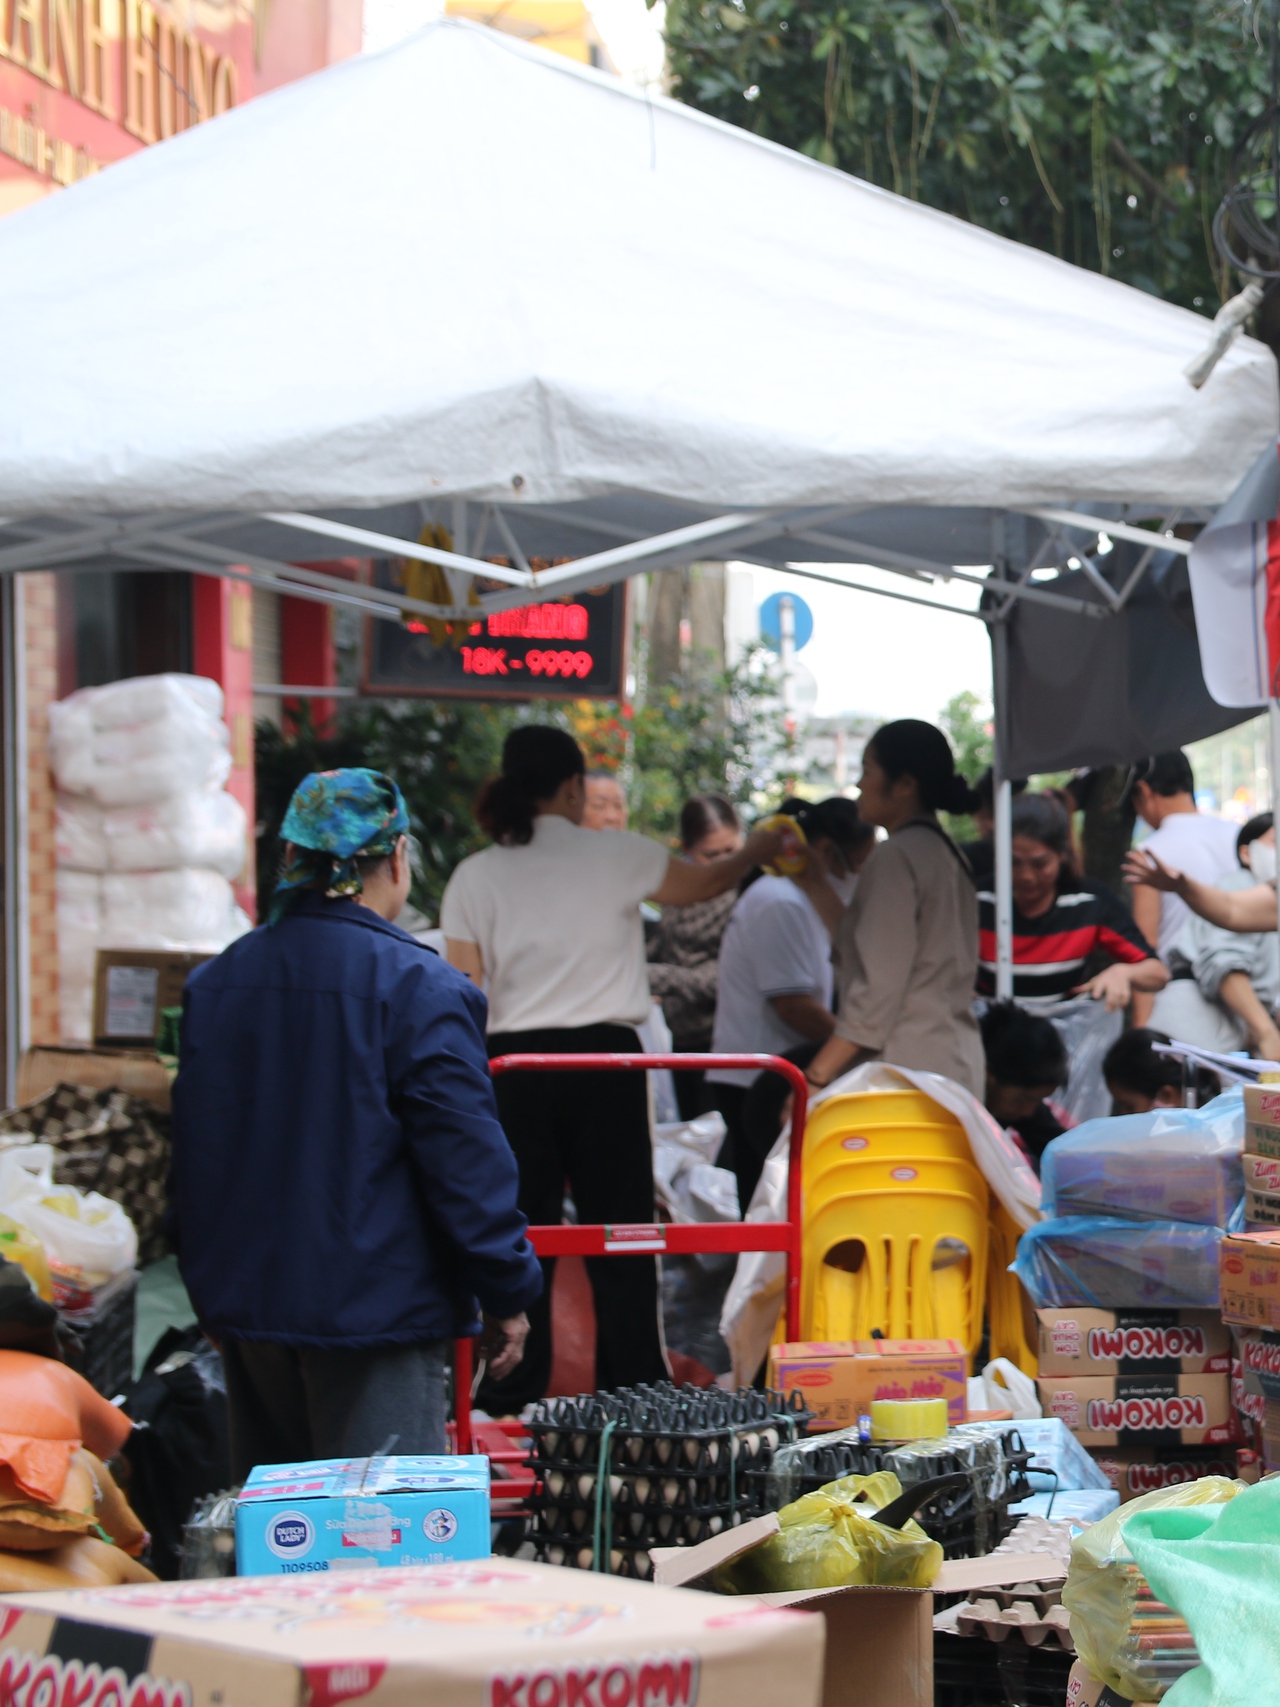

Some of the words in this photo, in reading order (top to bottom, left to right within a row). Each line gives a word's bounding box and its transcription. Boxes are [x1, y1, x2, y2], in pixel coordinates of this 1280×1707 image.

[1091, 1328, 1204, 1358] KOKOMI
[1091, 1398, 1204, 1430] KOKOMI
[276, 1526, 304, 1536] DUTCH
[280, 1534, 302, 1543] LADY
[281, 1561, 329, 1573] 1109508
[491, 1658, 692, 1707] KOKOMI
